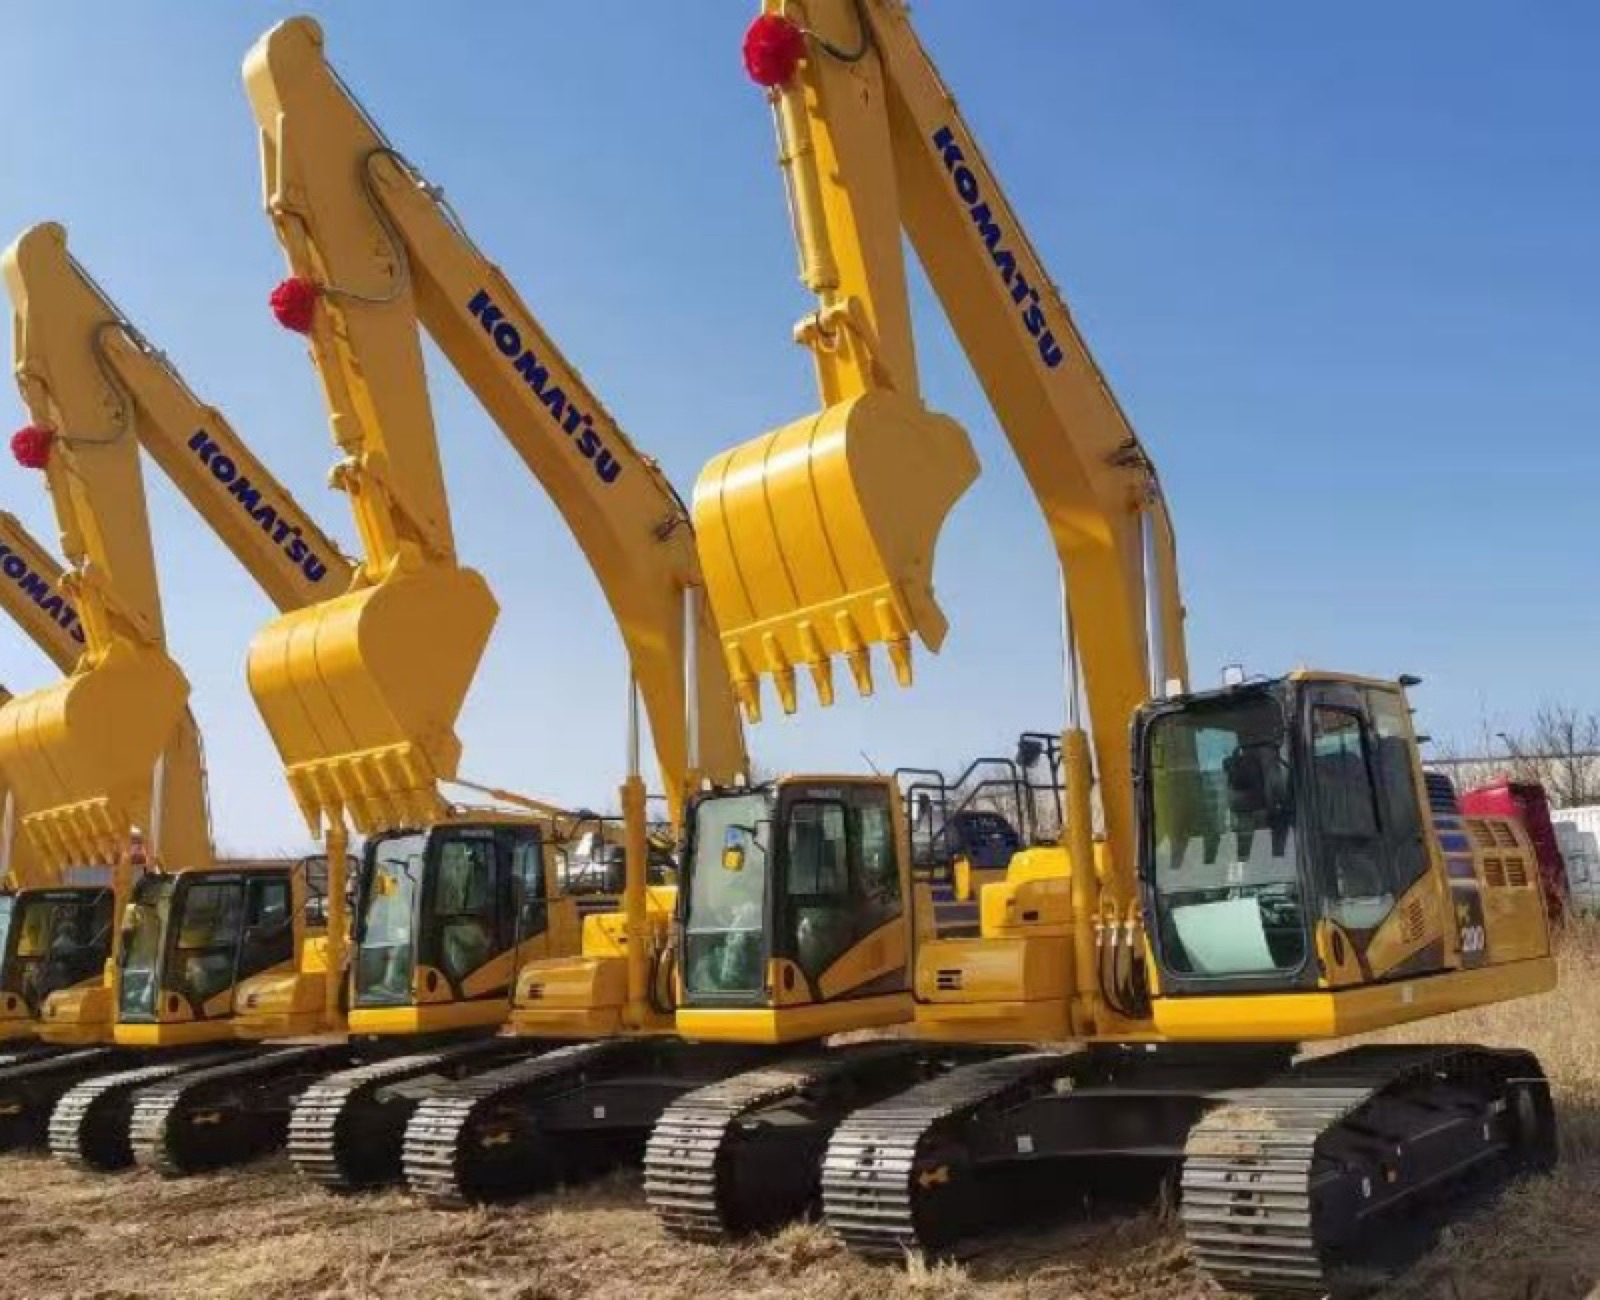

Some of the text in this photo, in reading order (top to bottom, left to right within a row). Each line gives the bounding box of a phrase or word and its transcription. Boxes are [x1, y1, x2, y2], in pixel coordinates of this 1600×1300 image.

[932, 125, 1063, 368] KOMATSU
[467, 289, 622, 484] KOMATSU
[187, 429, 327, 583] KOMATSU
